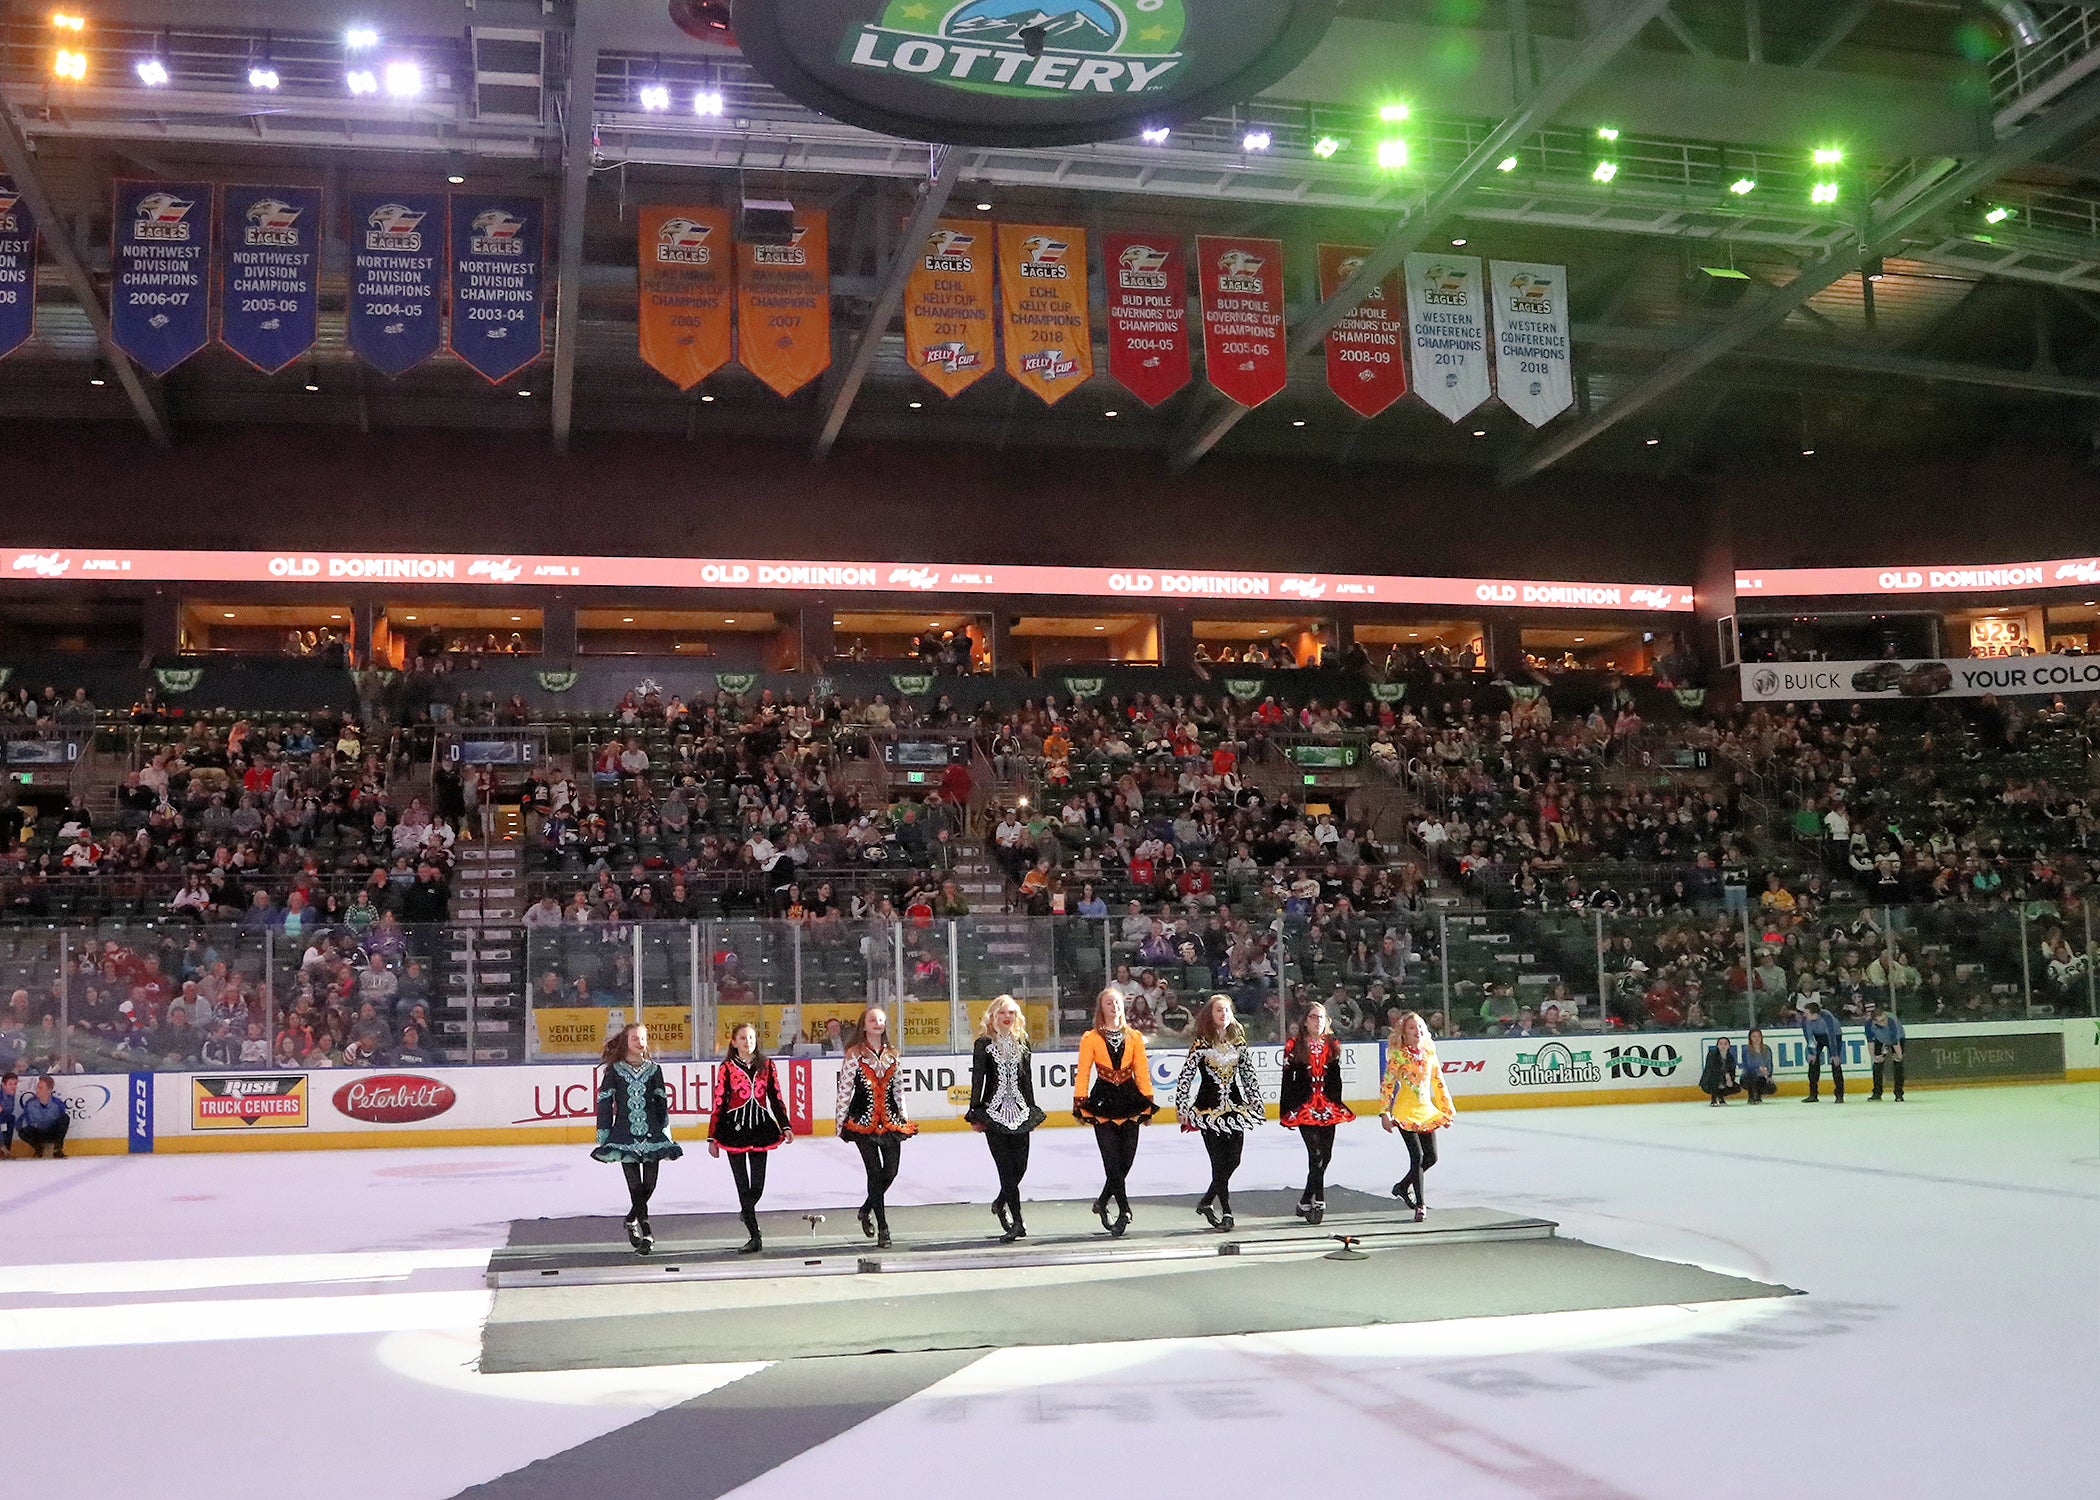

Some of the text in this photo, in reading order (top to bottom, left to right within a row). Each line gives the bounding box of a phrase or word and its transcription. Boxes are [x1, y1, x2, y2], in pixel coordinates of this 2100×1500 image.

[850, 31, 1179, 94] LOTTERY
[136, 221, 190, 240] EAGLES
[246, 228, 299, 245] EAGLES
[367, 231, 421, 250] EAGLES
[472, 237, 523, 255] EAGLES
[123, 245, 201, 259] NORTHWEST
[233, 252, 310, 266] NORTHWEST
[658, 244, 709, 263] EAGLES
[755, 245, 805, 264] EAGLES
[133, 260, 190, 272] DIVISION
[356, 255, 433, 269] NORTHWEST
[459, 260, 535, 275] NORTHWEST
[925, 255, 973, 272] EAGLES
[244, 266, 298, 279] DIVISION
[367, 270, 422, 283] DIVISION
[1020, 262, 1067, 279] EAGLES
[122, 273, 199, 286] CHAMPIONS
[233, 279, 307, 293] CHAMPIONS
[470, 275, 524, 288] DIVISION
[933, 279, 964, 291] ECHL
[1121, 271, 1167, 288] EAGLES
[1219, 276, 1263, 293] EAGLES
[357, 283, 431, 297] CHAMPIONS
[460, 288, 533, 302] CHAMPIONS
[1029, 286, 1059, 298] ECHL
[128, 292, 190, 305] 2006-07
[652, 295, 719, 309] CHAMPIONS
[751, 297, 816, 309] CHAMPIONS
[923, 293, 976, 306] KELLY CUP
[1121, 295, 1172, 307] BUD POILE
[1424, 289, 1468, 306] EAGLES
[241, 299, 298, 313] 2005-06
[365, 303, 422, 317] 2004-05
[1019, 300, 1072, 312] KELLY CUP
[1217, 299, 1270, 313] BUD POILE
[1510, 297, 1552, 314] EAGLES
[468, 307, 525, 321] 2003-04
[914, 306, 986, 320] CHAMPIONS
[1010, 313, 1082, 327] CHAMPIONS
[1166, 308, 1185, 320] CUP
[1262, 314, 1282, 326] CUP
[1359, 308, 1387, 320] POILE
[1422, 312, 1473, 325] WESTERN
[768, 316, 801, 328] 2007
[934, 322, 967, 335] 2017
[1119, 320, 1178, 332] CHAMPIONS
[1381, 321, 1401, 332] CUP
[1507, 319, 1557, 333] WESTERN
[1031, 330, 1064, 343] 2018
[1213, 325, 1276, 339] CHAMPIONS
[1332, 330, 1396, 345] CHAMPIONS
[1415, 324, 1482, 339] CONFERENCE
[1126, 338, 1174, 351] 2004-05
[1417, 337, 1482, 351] CHAMPIONS
[1501, 331, 1565, 347] CONFERENCE
[927, 349, 976, 366] KELLY CUP
[1339, 349, 1391, 364] 2008-09
[1434, 353, 1465, 366] 2017
[1502, 345, 1565, 360] CHAMPIONS
[1025, 357, 1073, 374] KELLY CUP
[1520, 361, 1549, 374] 2018
[268, 557, 320, 577] OLD
[328, 558, 455, 578] DOMINION
[701, 564, 750, 583] OLD
[758, 565, 877, 586] DOMINION
[1878, 571, 1923, 589] OLD
[1930, 566, 2043, 588] DOMINION
[1108, 573, 1154, 592] OLD
[1160, 574, 1270, 595] DOMINION
[1475, 584, 1517, 601] OLD
[1523, 585, 1621, 605] DOMINION
[1974, 621, 2021, 642] 92.9
[1784, 671, 1841, 690] BUICK
[1962, 669, 2027, 688] YOUR
[67, 742, 78, 761] D
[450, 744, 460, 762] D
[522, 744, 532, 762] E
[885, 745, 894, 762] E
[1345, 750, 1354, 766] G
[1698, 751, 1707, 767] H
[549, 1024, 596, 1034] VENTURE
[645, 1023, 684, 1033] ENTURE
[903, 1017, 939, 1027] ENTURE
[549, 1034, 596, 1043] COOLERS
[1603, 1044, 1679, 1080] 100
[1931, 1046, 2016, 1069] THE TAVERN
[1508, 1061, 1601, 1087] Sutherlands
[346, 1080, 446, 1110] Peterbilt
[795, 1064, 807, 1121] CCM
[136, 1079, 147, 1138] CCM
[201, 1098, 300, 1115] TRUCK CENTERS
